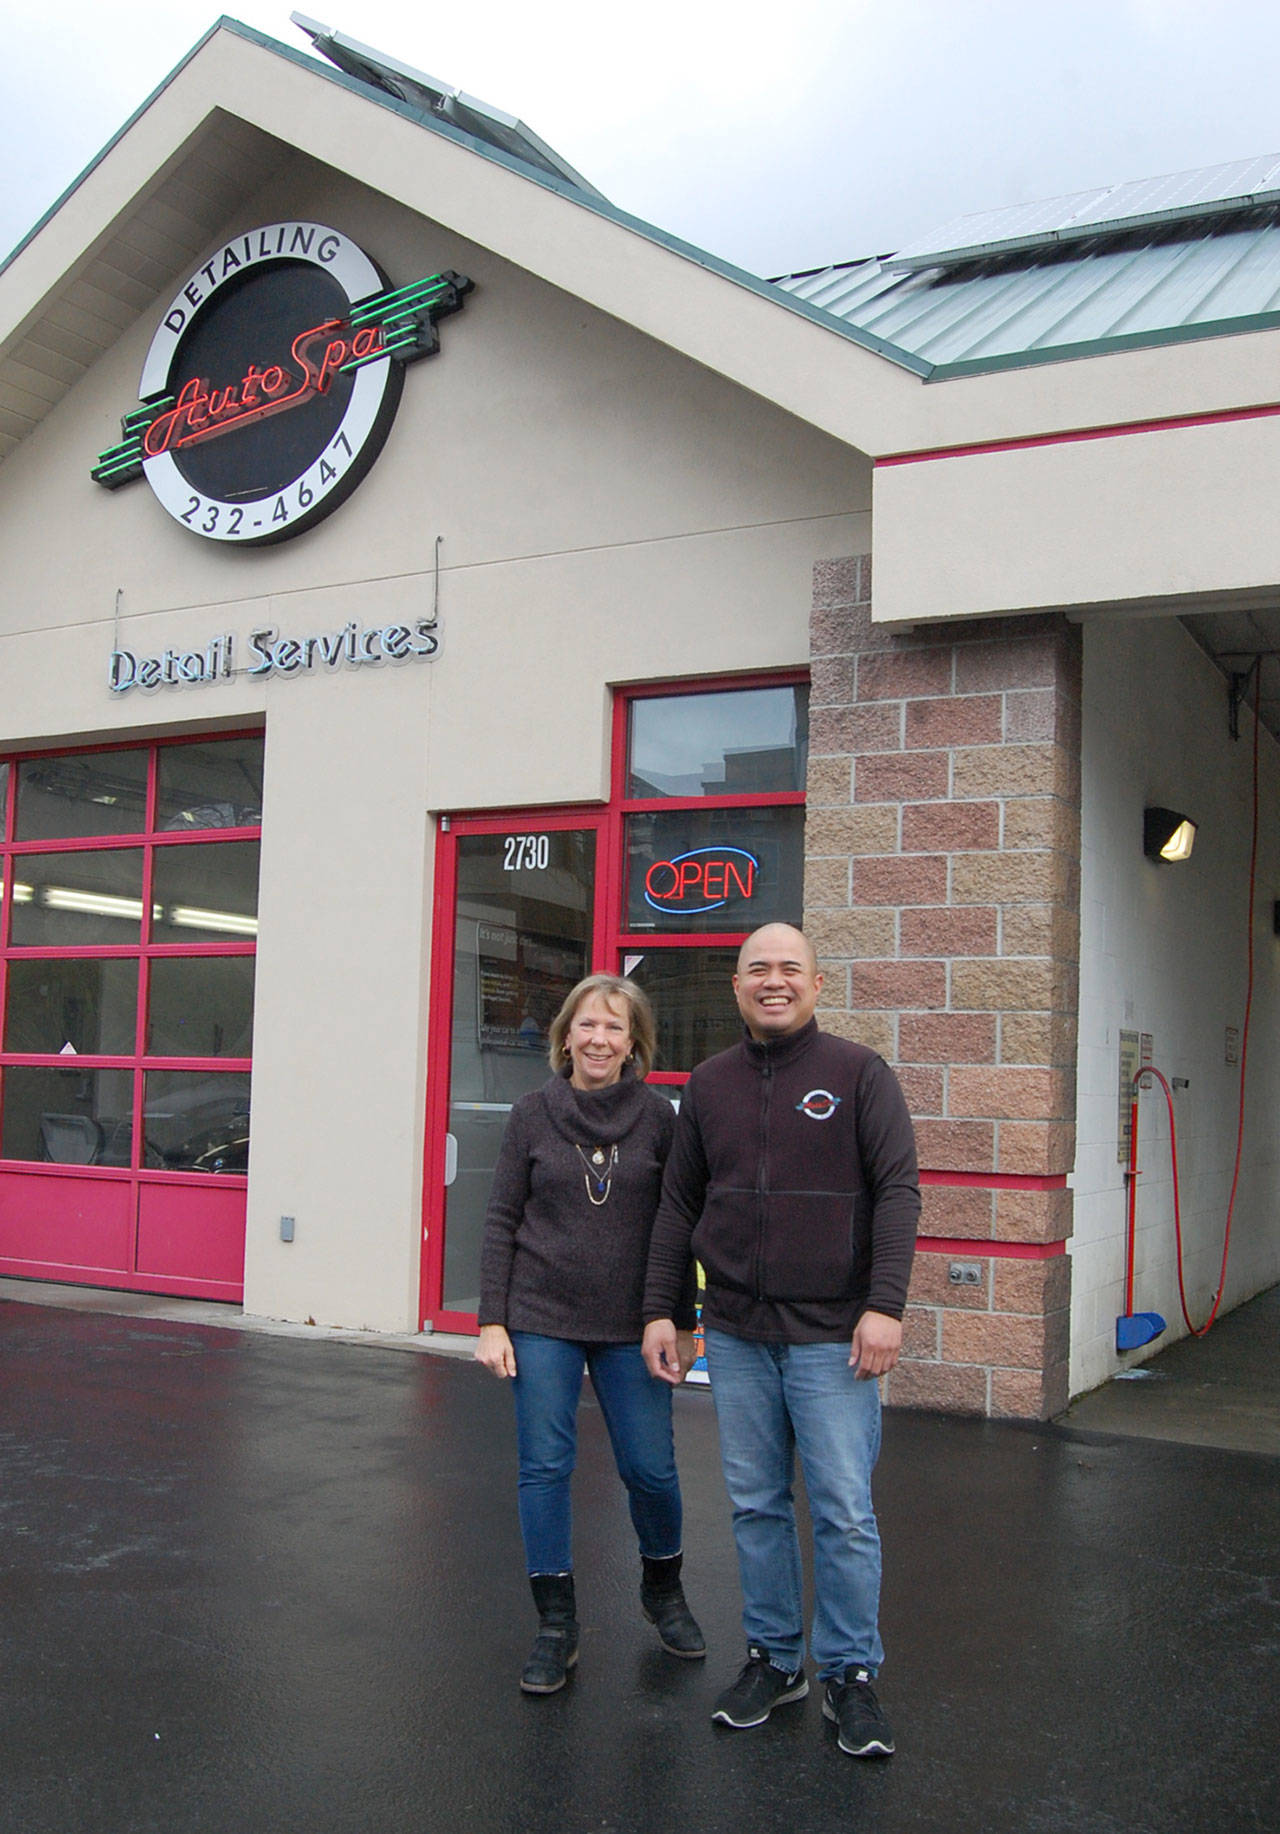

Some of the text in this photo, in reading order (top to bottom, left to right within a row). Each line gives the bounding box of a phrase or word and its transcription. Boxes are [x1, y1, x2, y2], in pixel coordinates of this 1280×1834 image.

[164, 226, 341, 334] DETAILING
[144, 319, 386, 455] Auto Spa
[181, 432, 354, 535] 232-4647
[108, 622, 439, 693] Detail Services
[504, 835, 549, 871] 2730
[646, 861, 754, 899] OPEN
